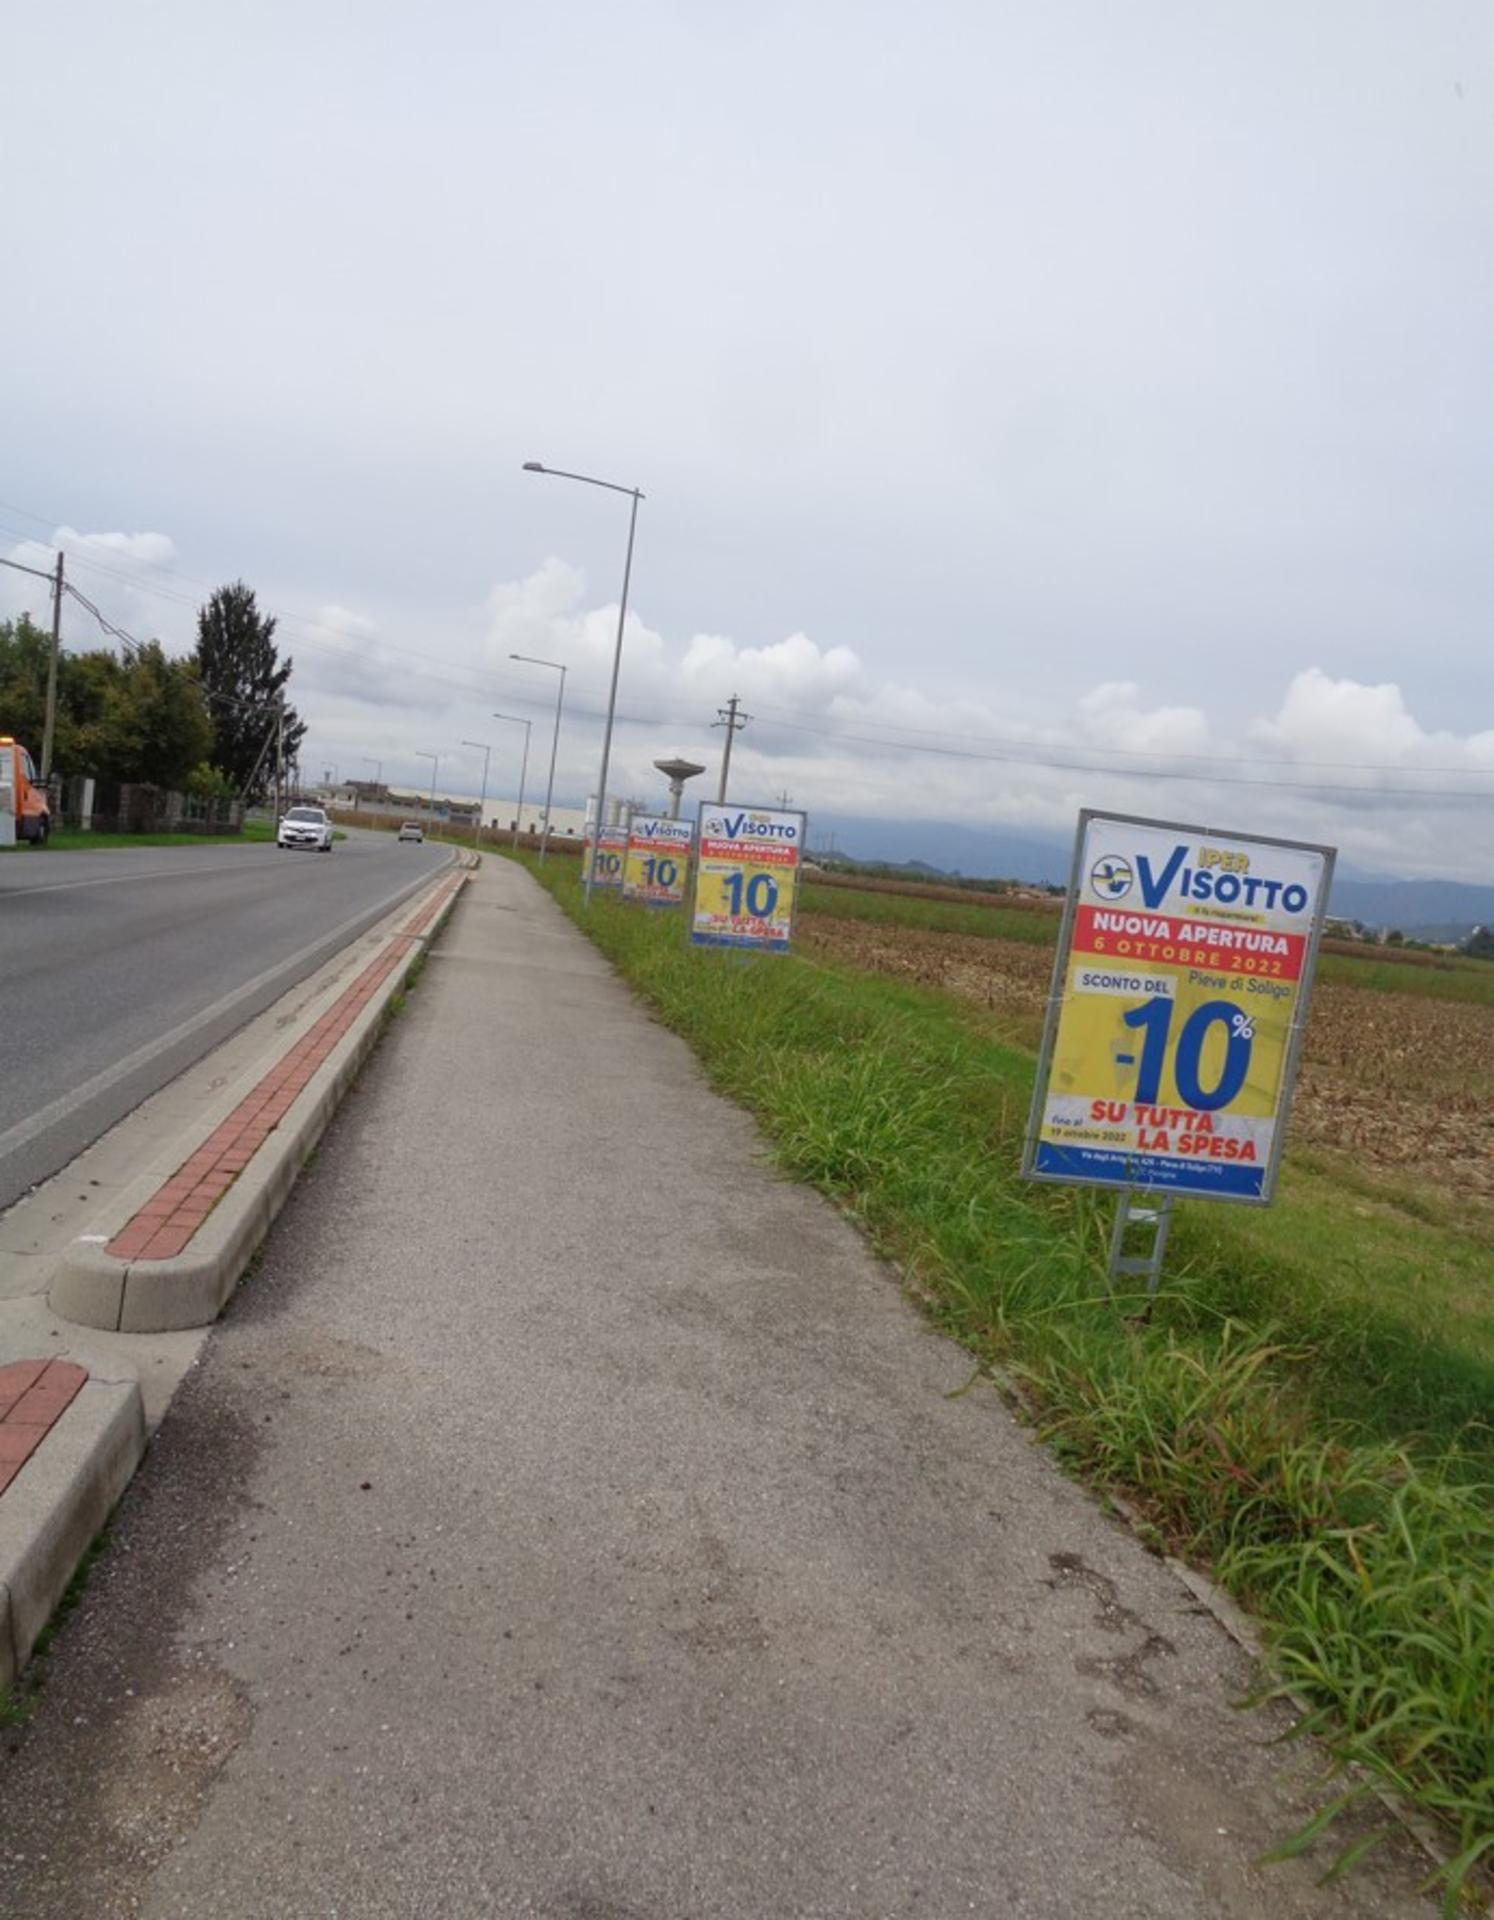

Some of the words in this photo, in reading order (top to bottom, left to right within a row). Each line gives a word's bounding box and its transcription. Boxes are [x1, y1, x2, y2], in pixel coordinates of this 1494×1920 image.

[724, 813, 796, 838] VISOTTO
[1198, 846, 1250, 874] IPER
[1136, 845, 1308, 914] VISOTTO
[1092, 911, 1171, 941] NUOVA
[1178, 924, 1289, 956] APERTURA
[1093, 936, 1105, 951] 6
[1116, 940, 1220, 966] OTTOBRE
[1231, 955, 1282, 975] 2022
[1082, 973, 1141, 991] SCONTO
[1144, 979, 1170, 994] DEL
[1188, 970, 1227, 990] Pieve
[1230, 977, 1244, 991] di
[1247, 978, 1291, 999] Soligo
[1091, 1099, 1127, 1124] SU
[1133, 1105, 1214, 1134] TUTTA
[1137, 1129, 1170, 1151] LA
[1177, 1134, 1257, 1161] SPESA
